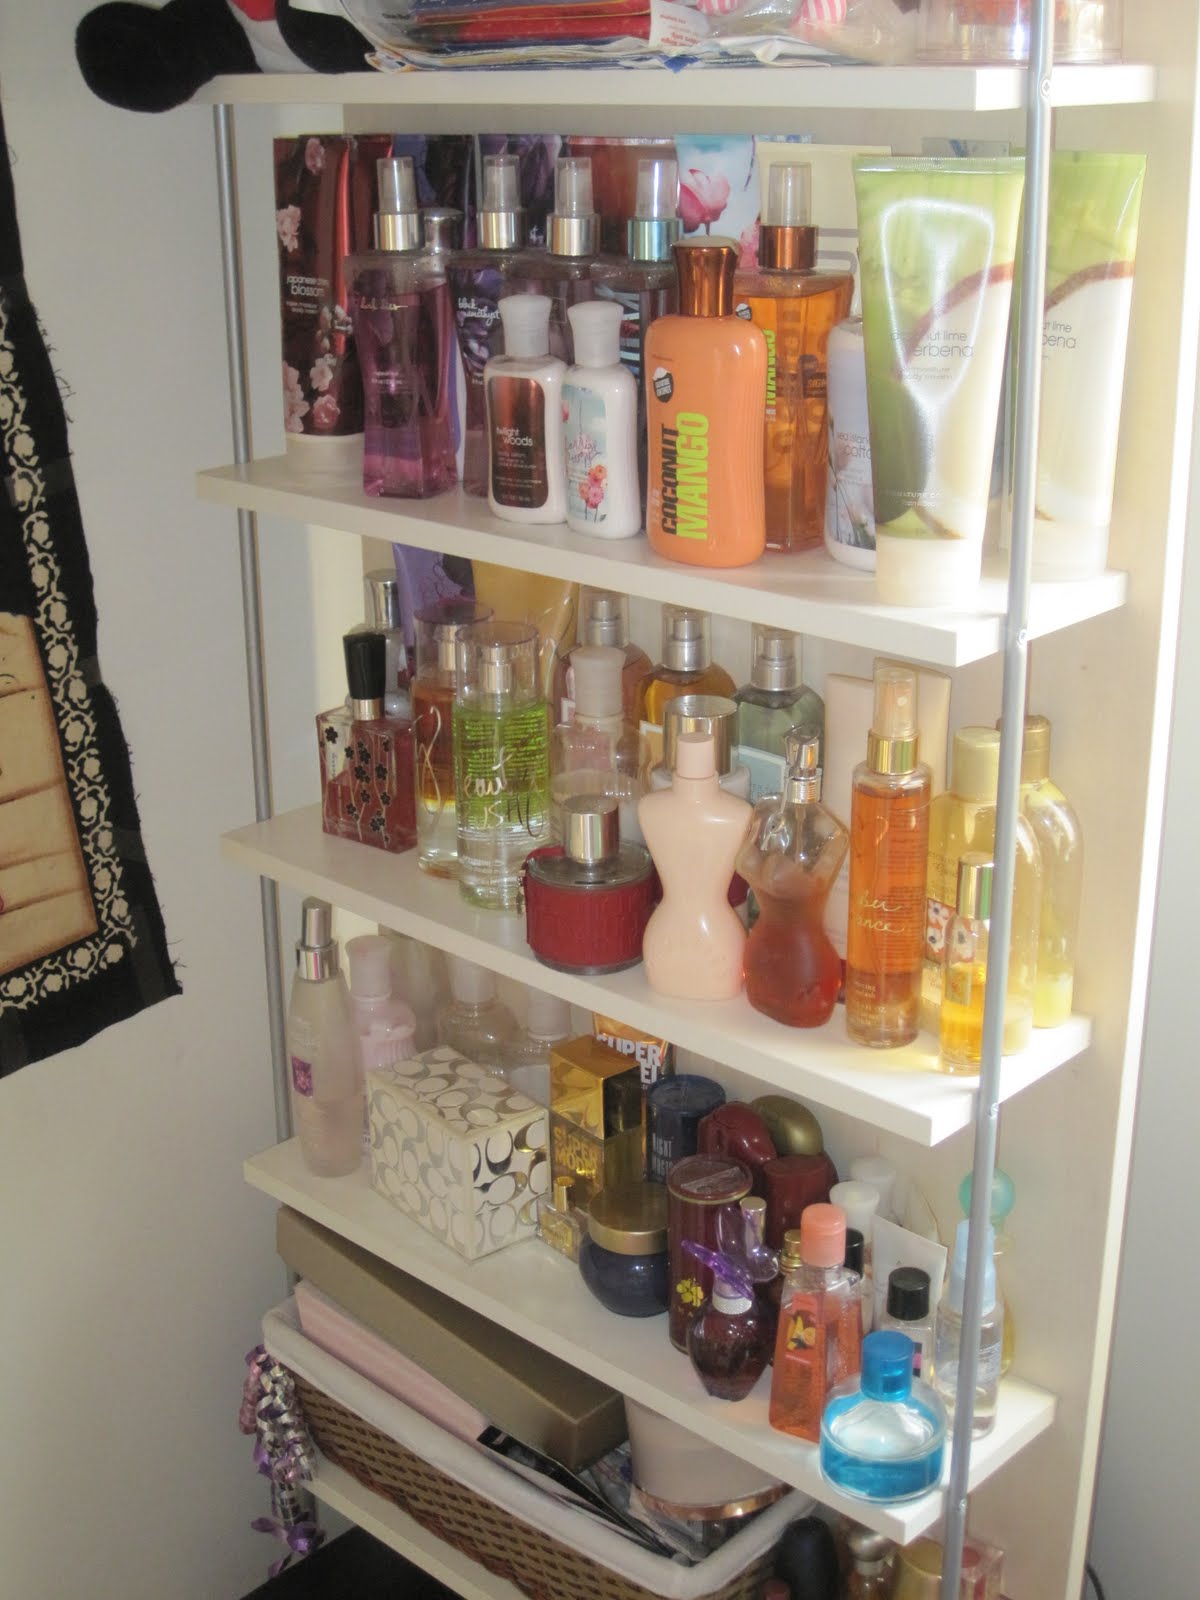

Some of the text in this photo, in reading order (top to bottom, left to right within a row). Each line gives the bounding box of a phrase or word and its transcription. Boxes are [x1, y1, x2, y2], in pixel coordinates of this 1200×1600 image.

[943, 330, 967, 341] lime
[1042, 334, 1077, 349] bena
[911, 344, 974, 358] erbena
[502, 436, 533, 447] woods
[843, 443, 872, 460] cotto
[661, 422, 679, 536] COCONUT
[676, 411, 709, 541] MANGO
